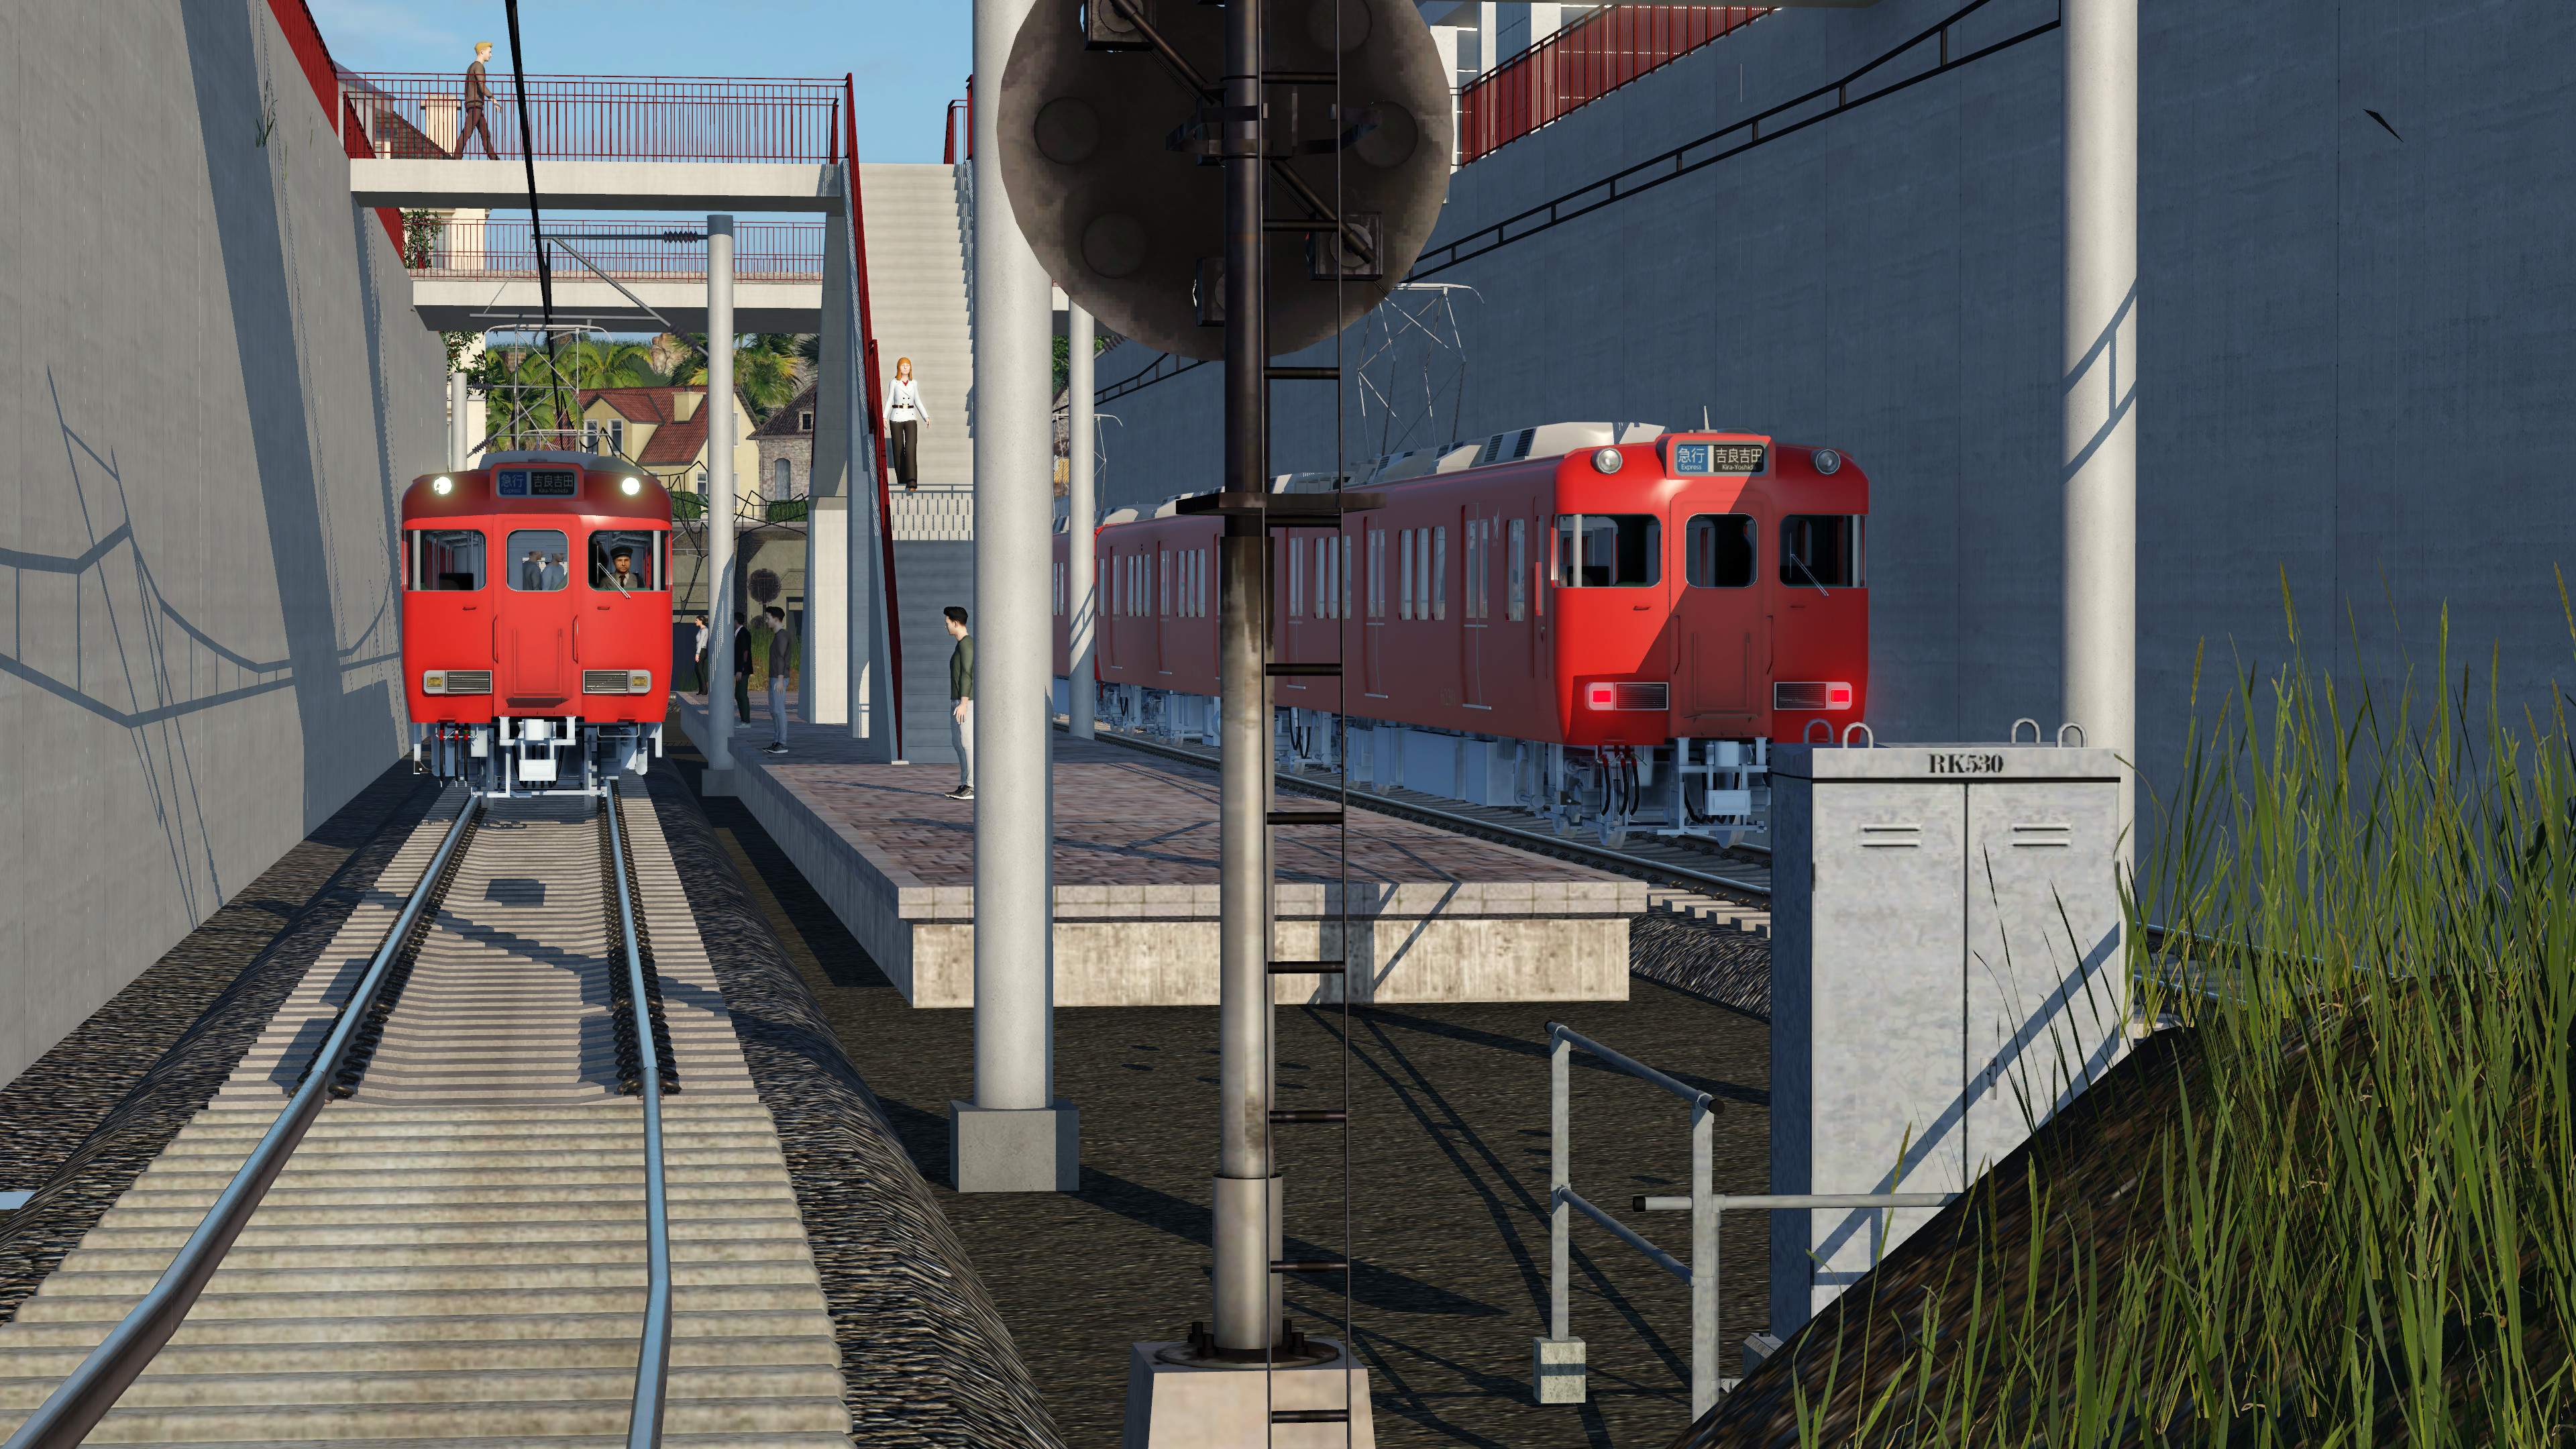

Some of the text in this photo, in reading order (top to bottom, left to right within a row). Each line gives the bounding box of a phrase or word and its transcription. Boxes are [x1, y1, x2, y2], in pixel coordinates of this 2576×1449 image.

[1678, 447, 1705, 464] 急行
[1716, 447, 1762, 464] 吉良吉田
[500, 474, 524, 488] 急行
[533, 474, 574, 488] 吉良吉田
[1927, 753, 2004, 773] RK530
